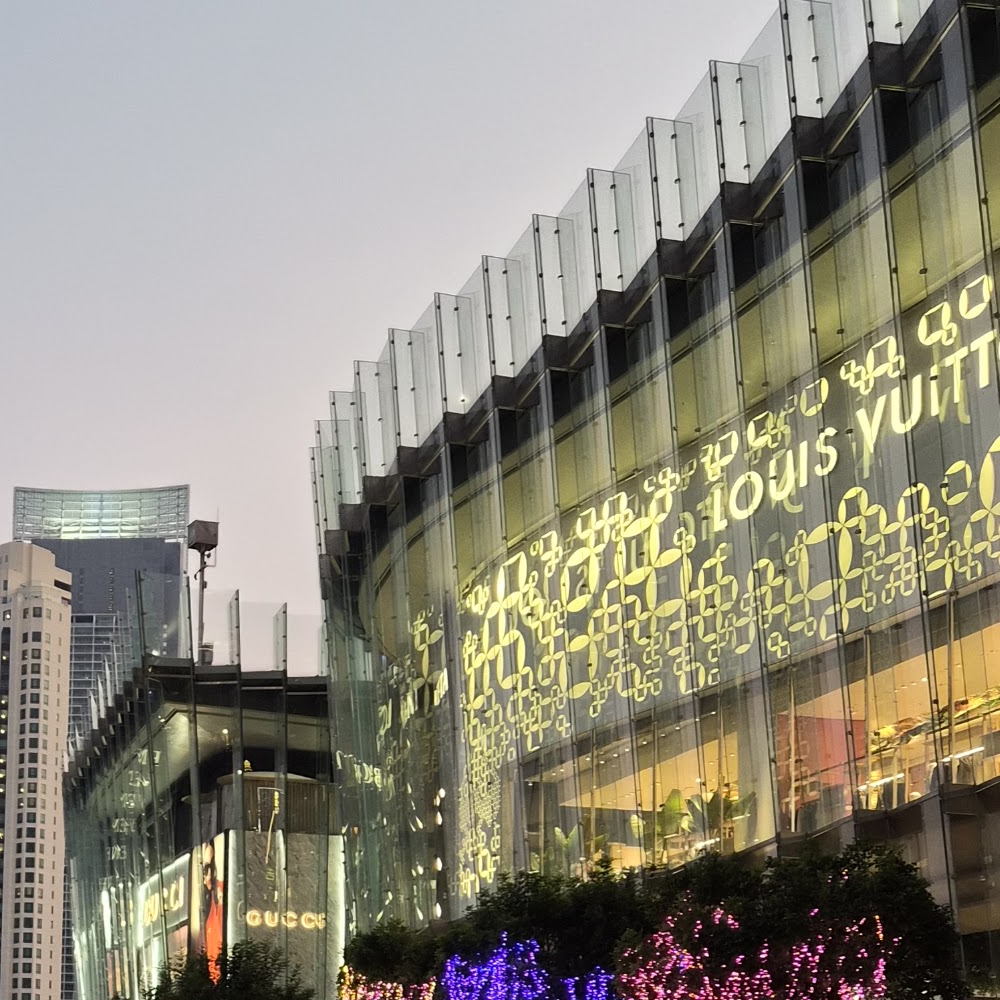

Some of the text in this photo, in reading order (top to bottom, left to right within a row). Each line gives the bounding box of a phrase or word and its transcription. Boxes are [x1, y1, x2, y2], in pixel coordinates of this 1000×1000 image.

[713, 329, 1000, 532] LOUIS VUITT
[246, 909, 326, 929] GUCCI
